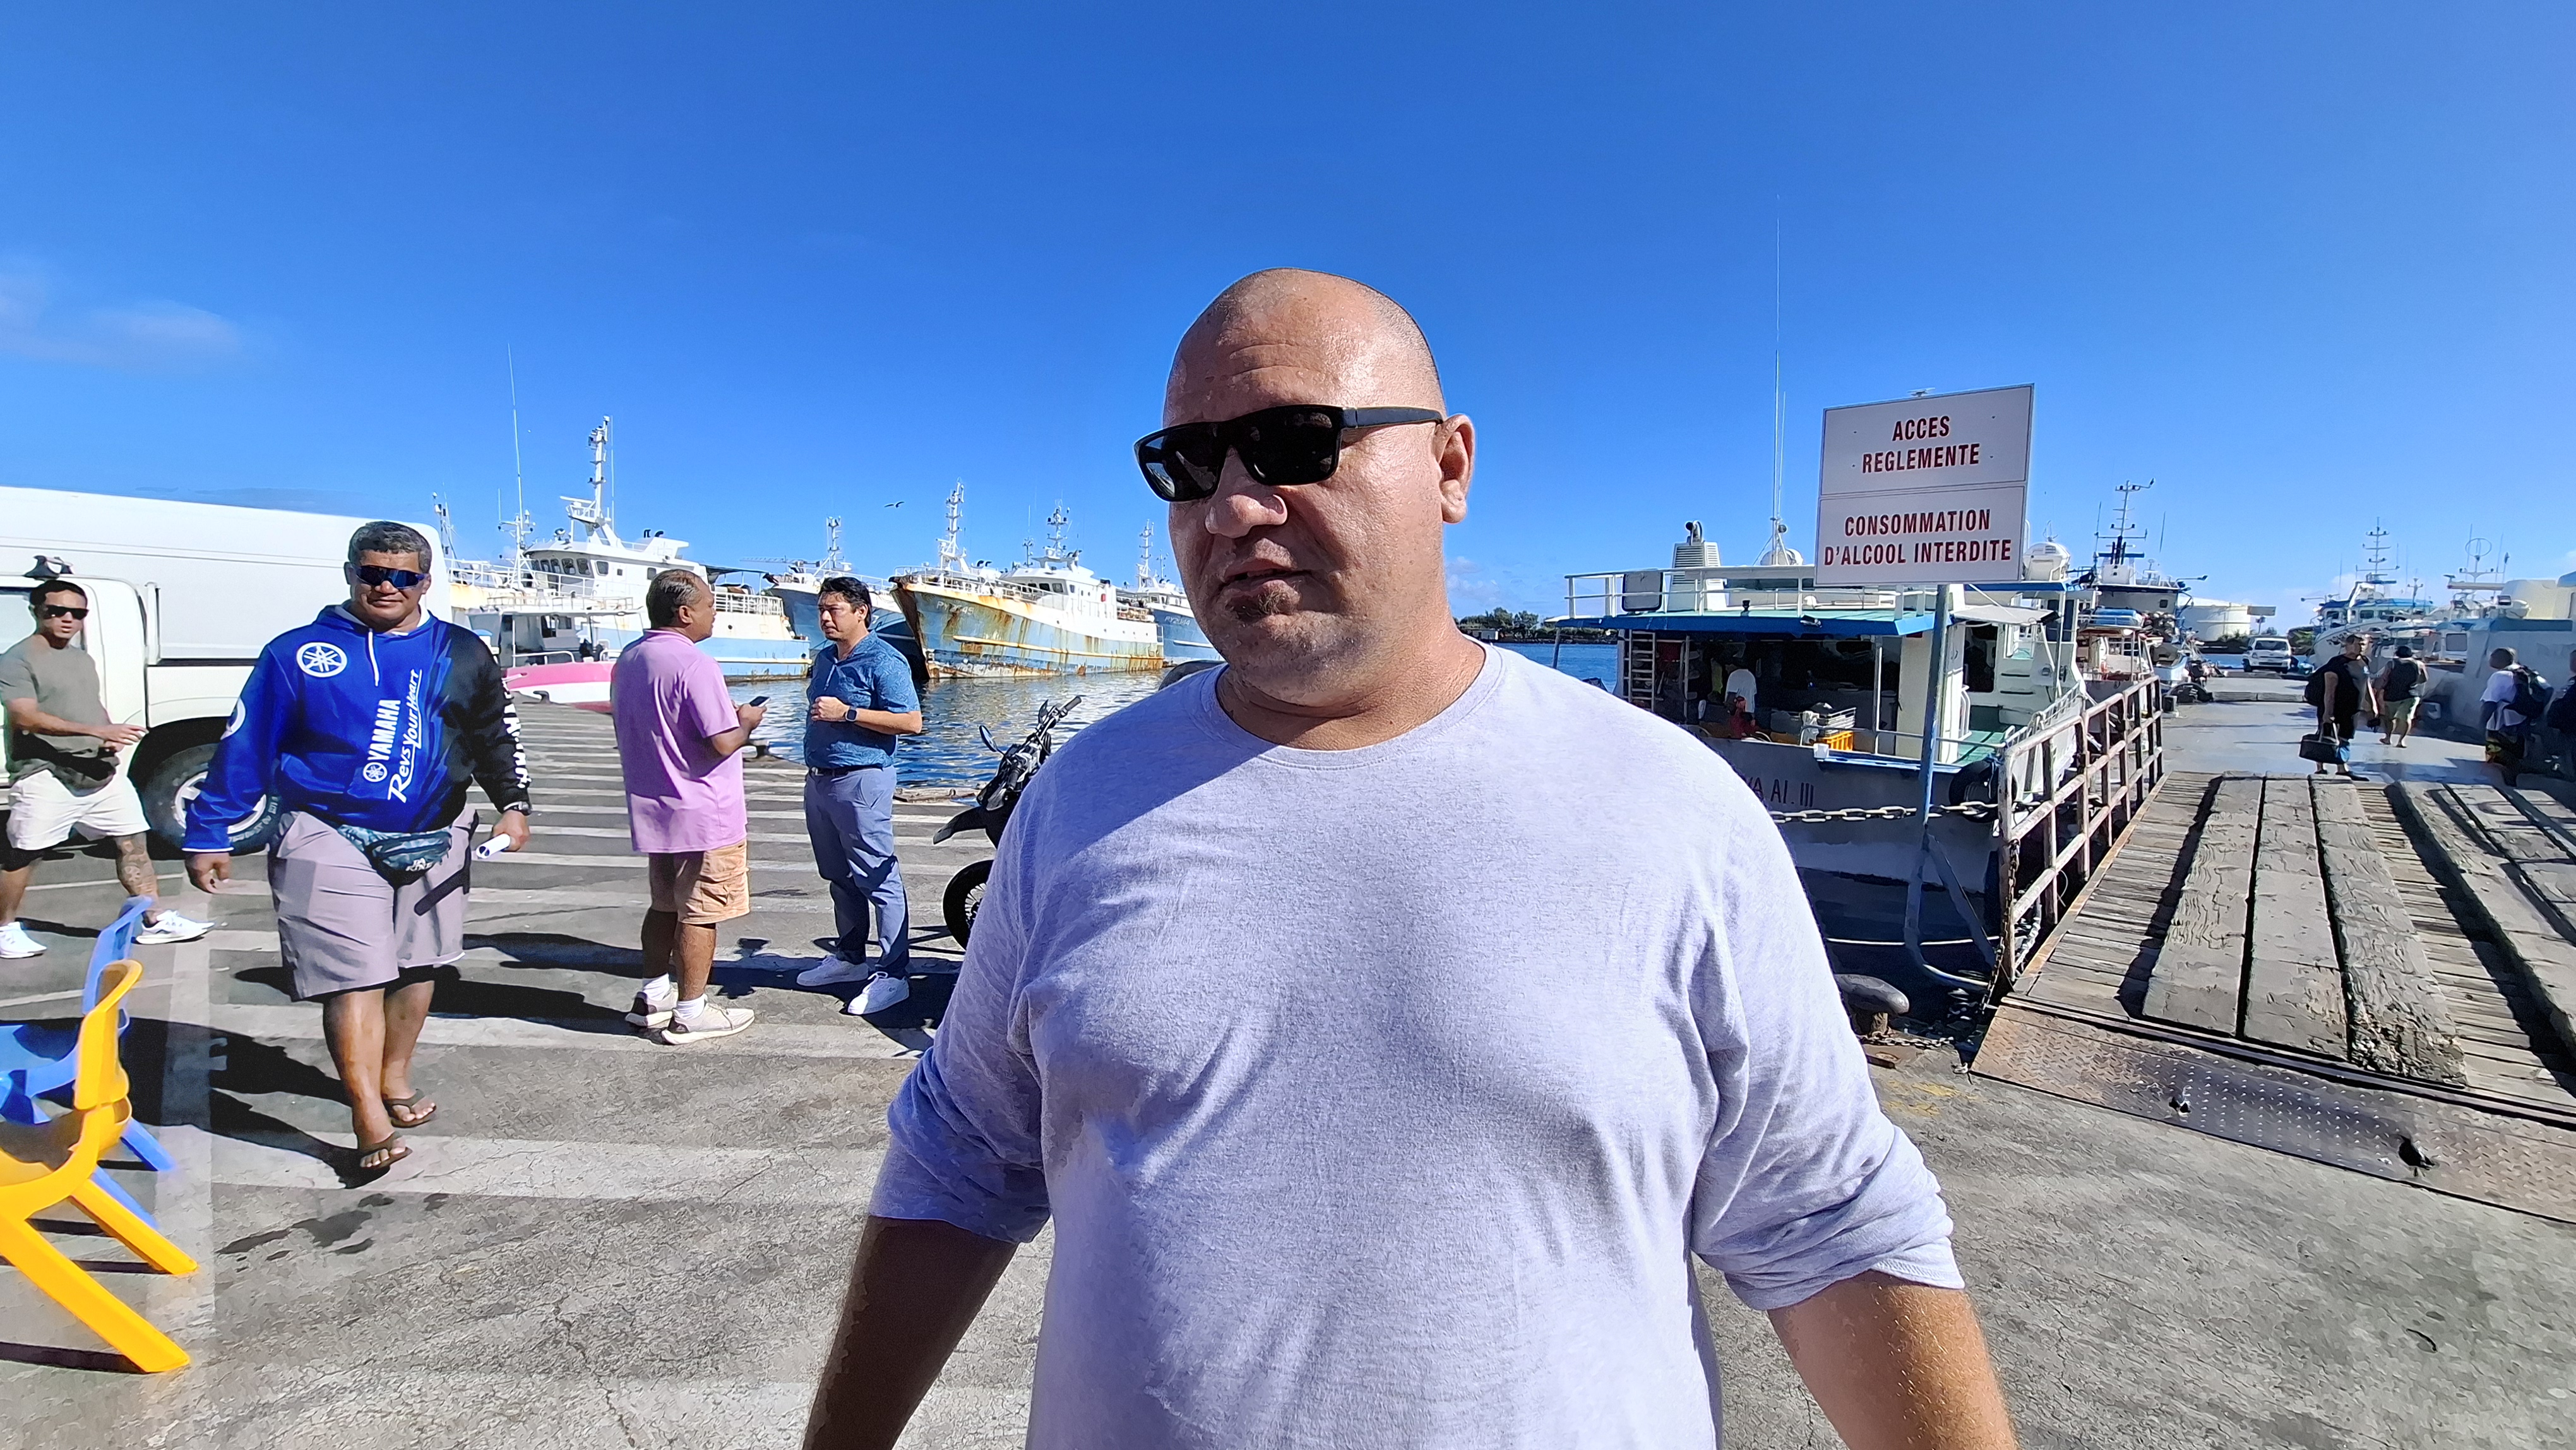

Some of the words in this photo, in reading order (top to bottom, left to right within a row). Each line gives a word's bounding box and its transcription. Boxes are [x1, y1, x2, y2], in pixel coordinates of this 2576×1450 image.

[1892, 416, 1950, 441] ACCES
[1862, 443, 1981, 474] REGLEMENTE
[1844, 508, 1991, 536] CONSOMMATION
[1824, 544, 1906, 565] D'ALCOOL
[1914, 539, 2012, 563] INTERDITE
[367, 699, 401, 761] YAMAHA
